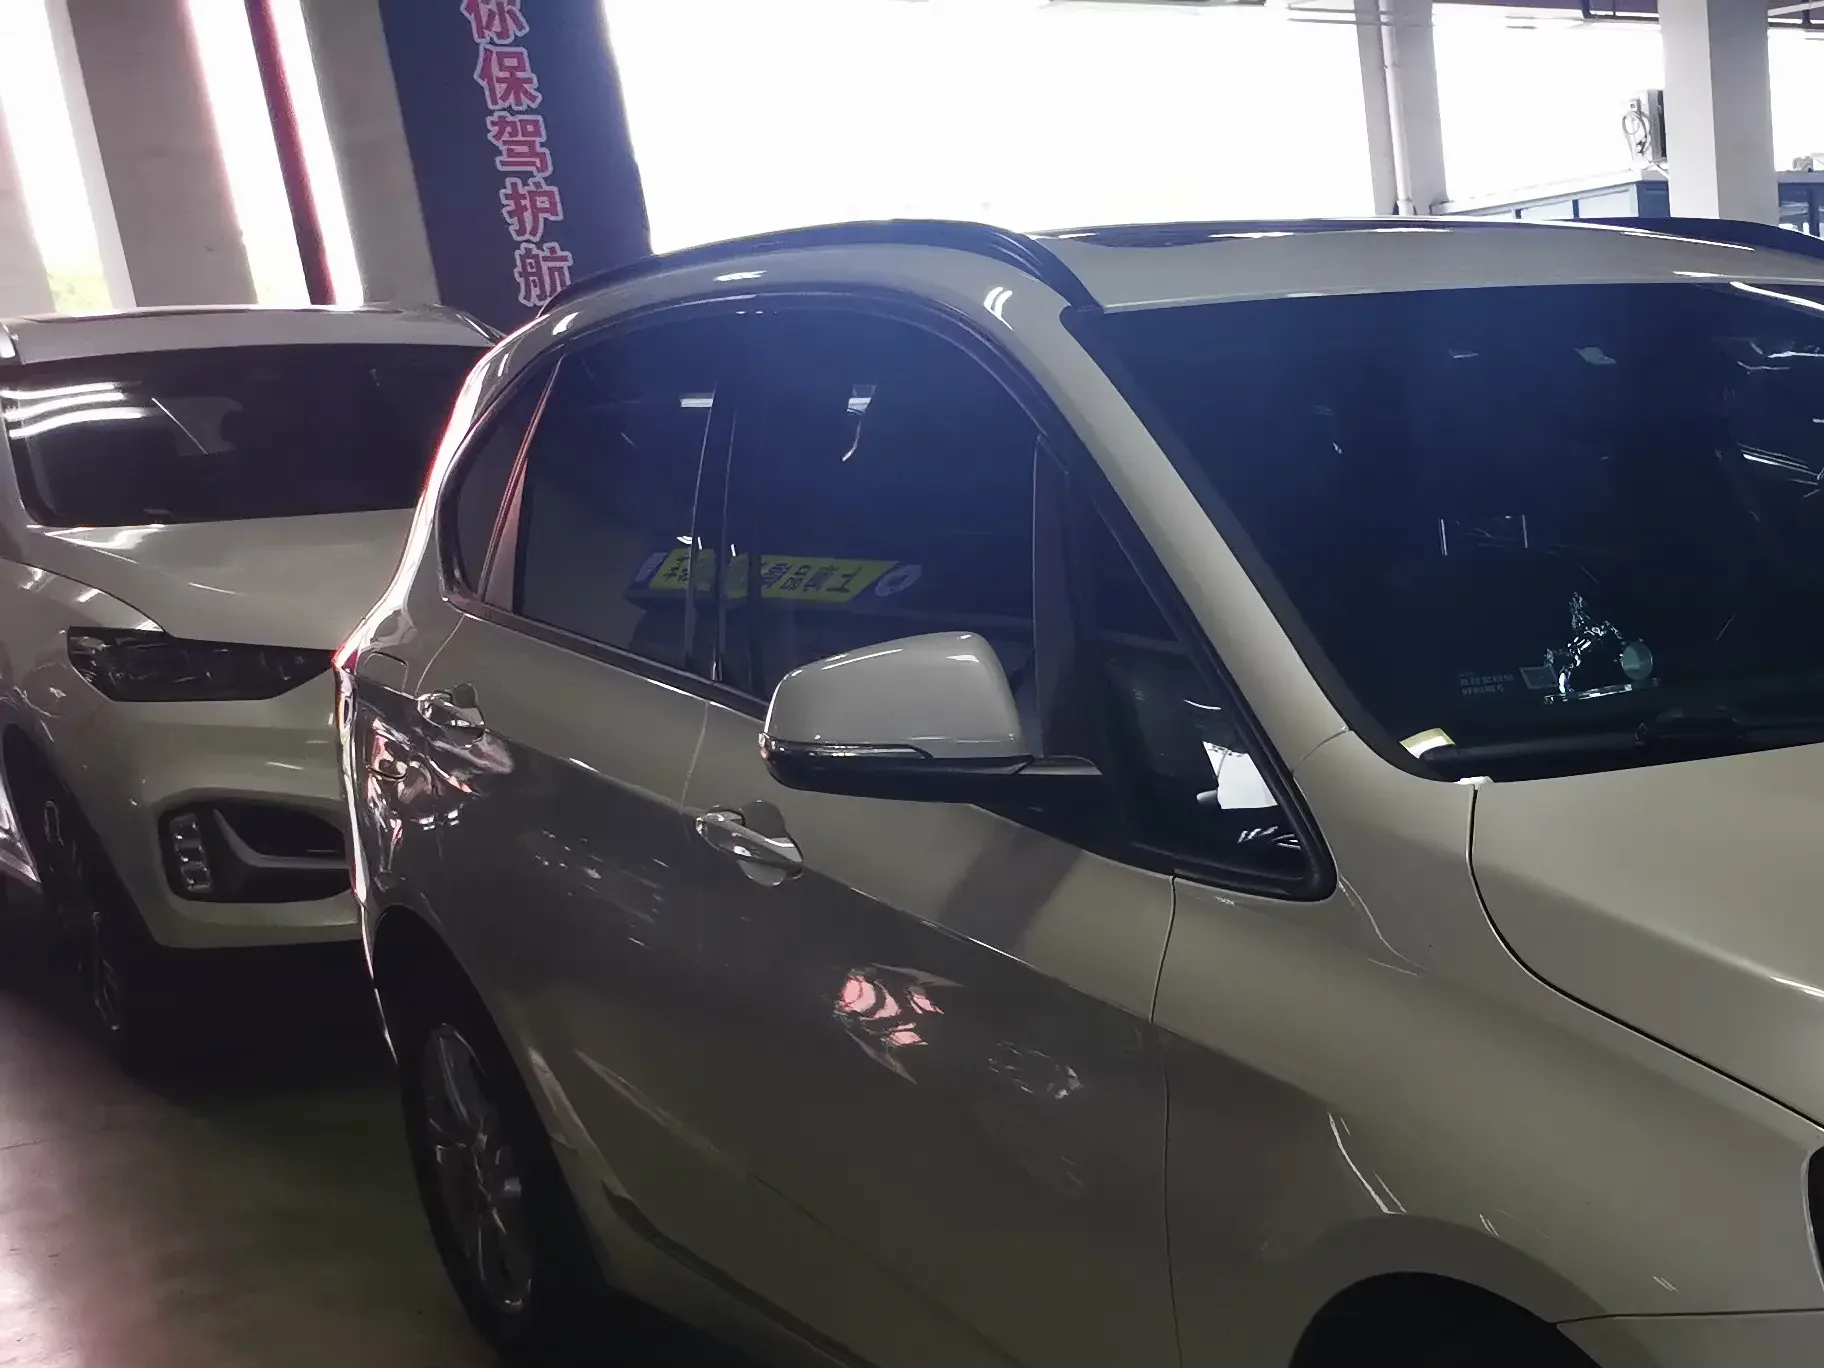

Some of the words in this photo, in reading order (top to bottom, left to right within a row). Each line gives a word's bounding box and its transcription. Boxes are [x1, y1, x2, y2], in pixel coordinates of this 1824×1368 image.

[461, 0, 575, 307] 你保驾护航
